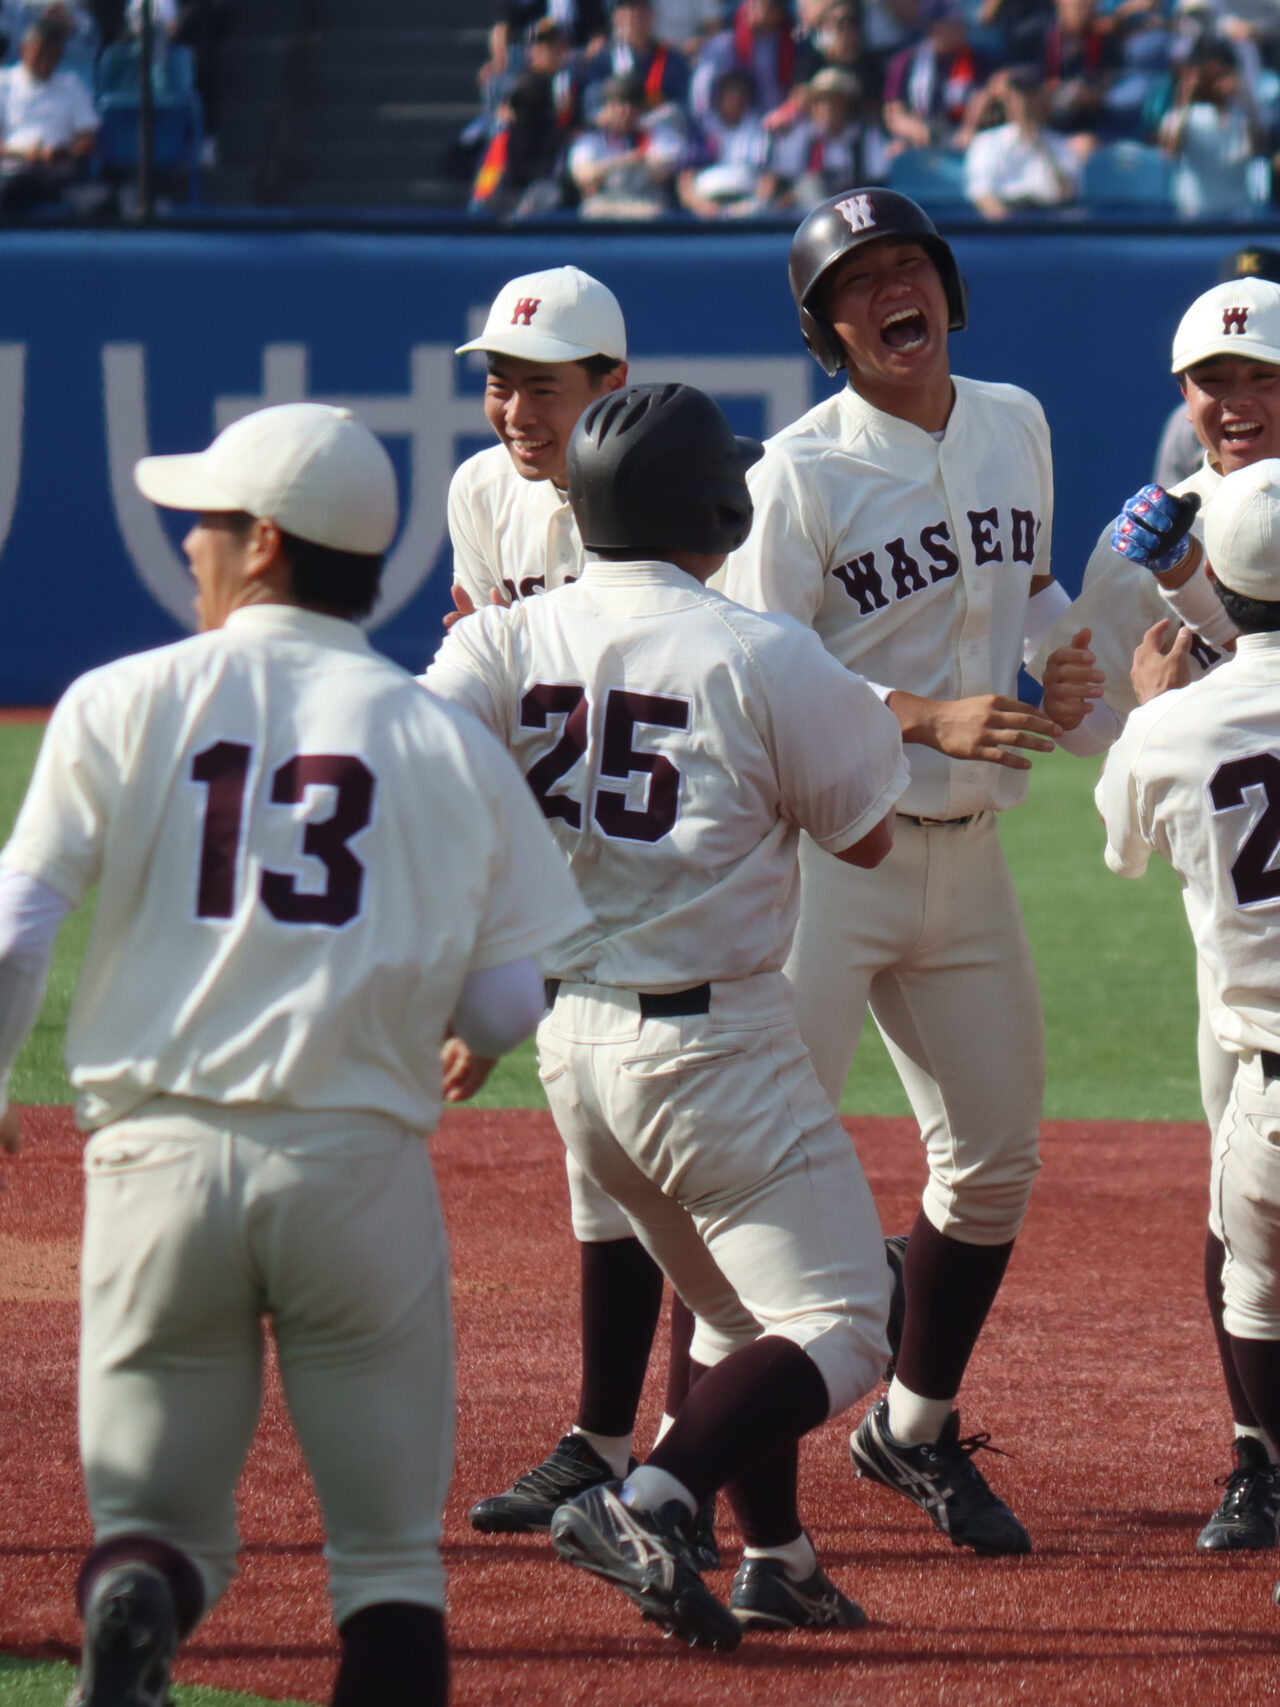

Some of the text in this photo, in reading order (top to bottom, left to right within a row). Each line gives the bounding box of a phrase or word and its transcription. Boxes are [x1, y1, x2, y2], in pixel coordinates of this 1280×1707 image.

[835, 194, 877, 234] W
[511, 298, 541, 325] W
[1222, 307, 1249, 335] W
[831, 506, 1042, 616] WASED
[520, 682, 691, 844] 25
[189, 739, 377, 929] 13
